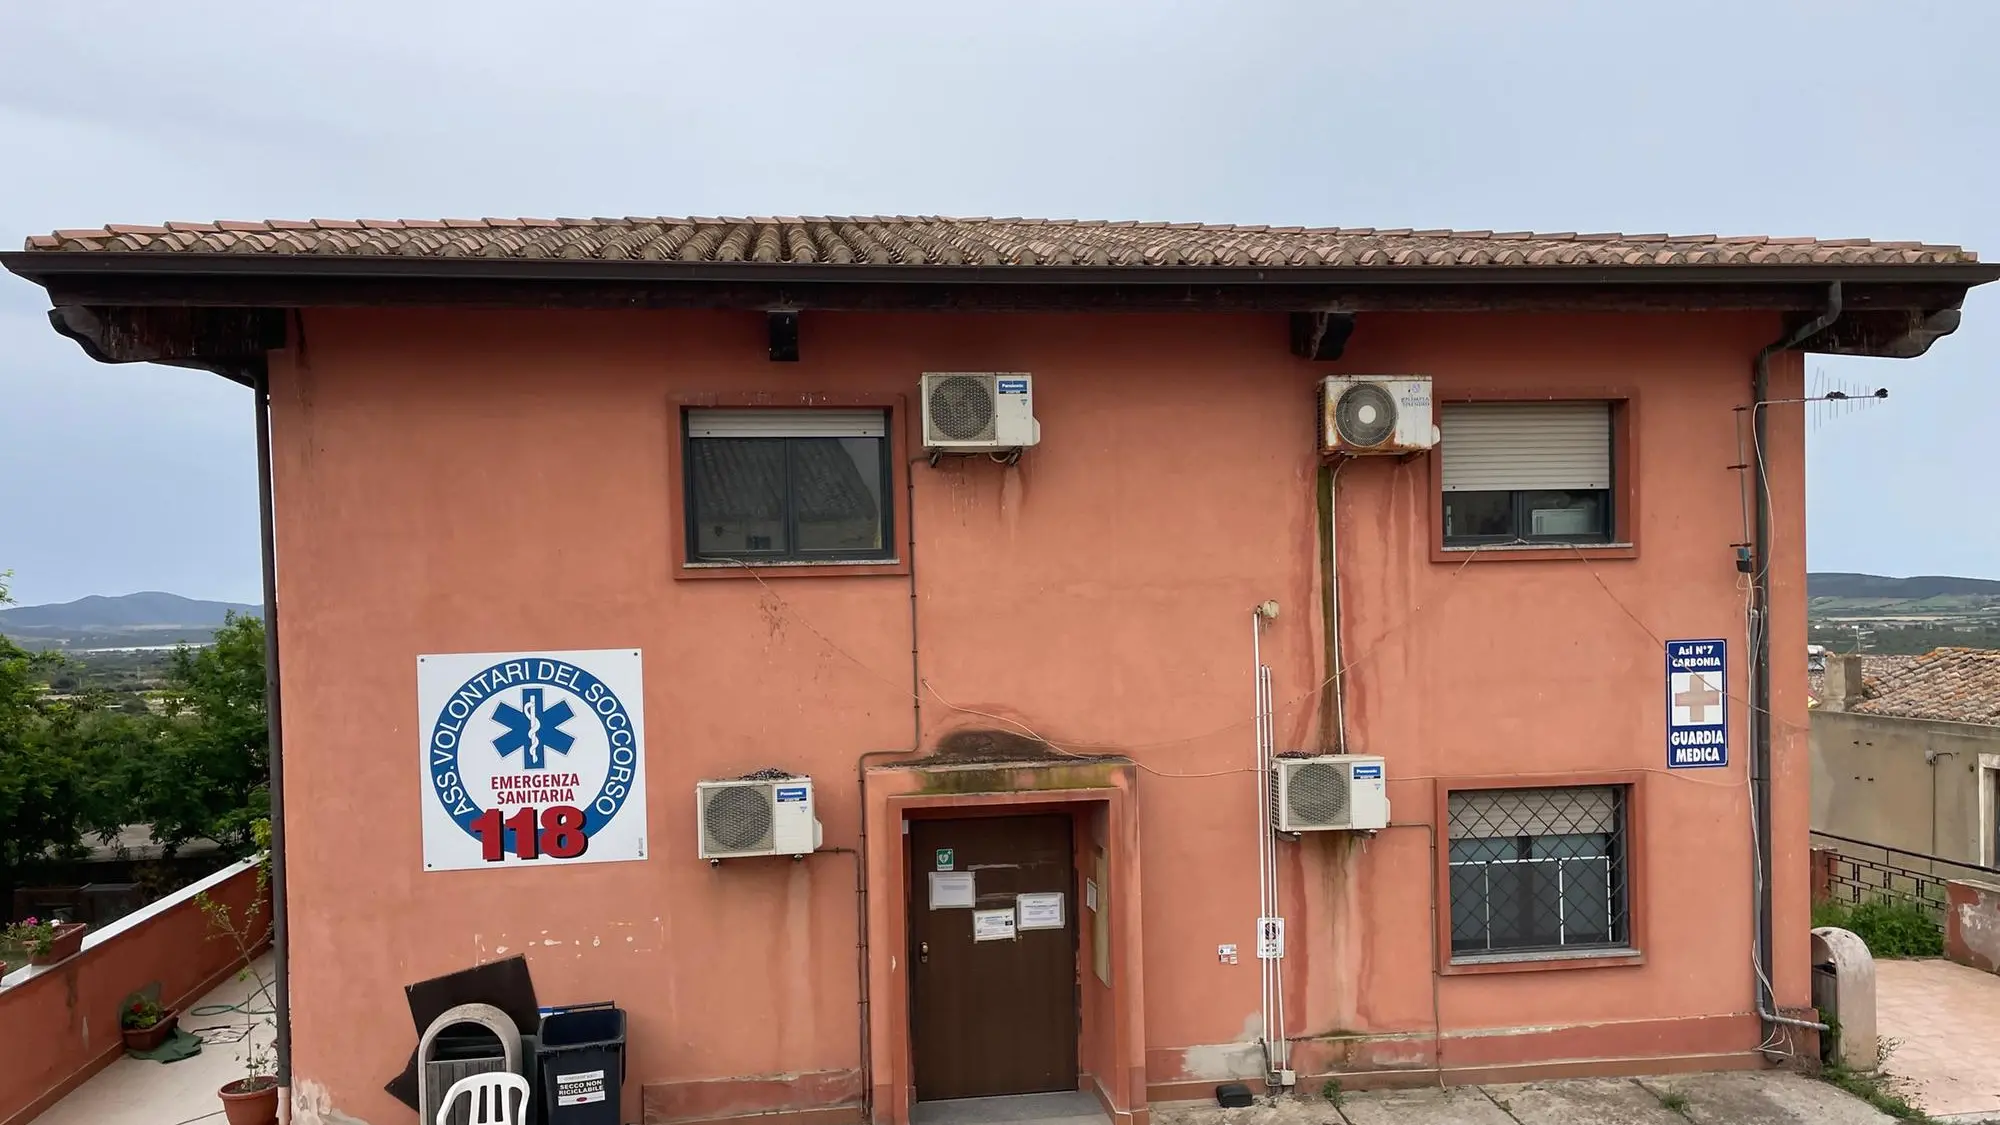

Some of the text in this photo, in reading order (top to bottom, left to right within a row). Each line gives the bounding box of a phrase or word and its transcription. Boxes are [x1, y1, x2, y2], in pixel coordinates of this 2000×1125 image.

[1678, 646, 1693, 656] Asl
[1672, 657, 1721, 668] CARBONIA
[537, 661, 581, 692] DEL
[585, 683, 633, 817] SOCCORSO
[1671, 730, 1724, 746] GUARDIA
[1676, 747, 1720, 763] MEDICA
[490, 773, 580, 790] EMERGENZA
[497, 788, 575, 805] SANITARIA
[470, 805, 589, 862] 118
[558, 1085, 603, 1095] RICICLABILE
